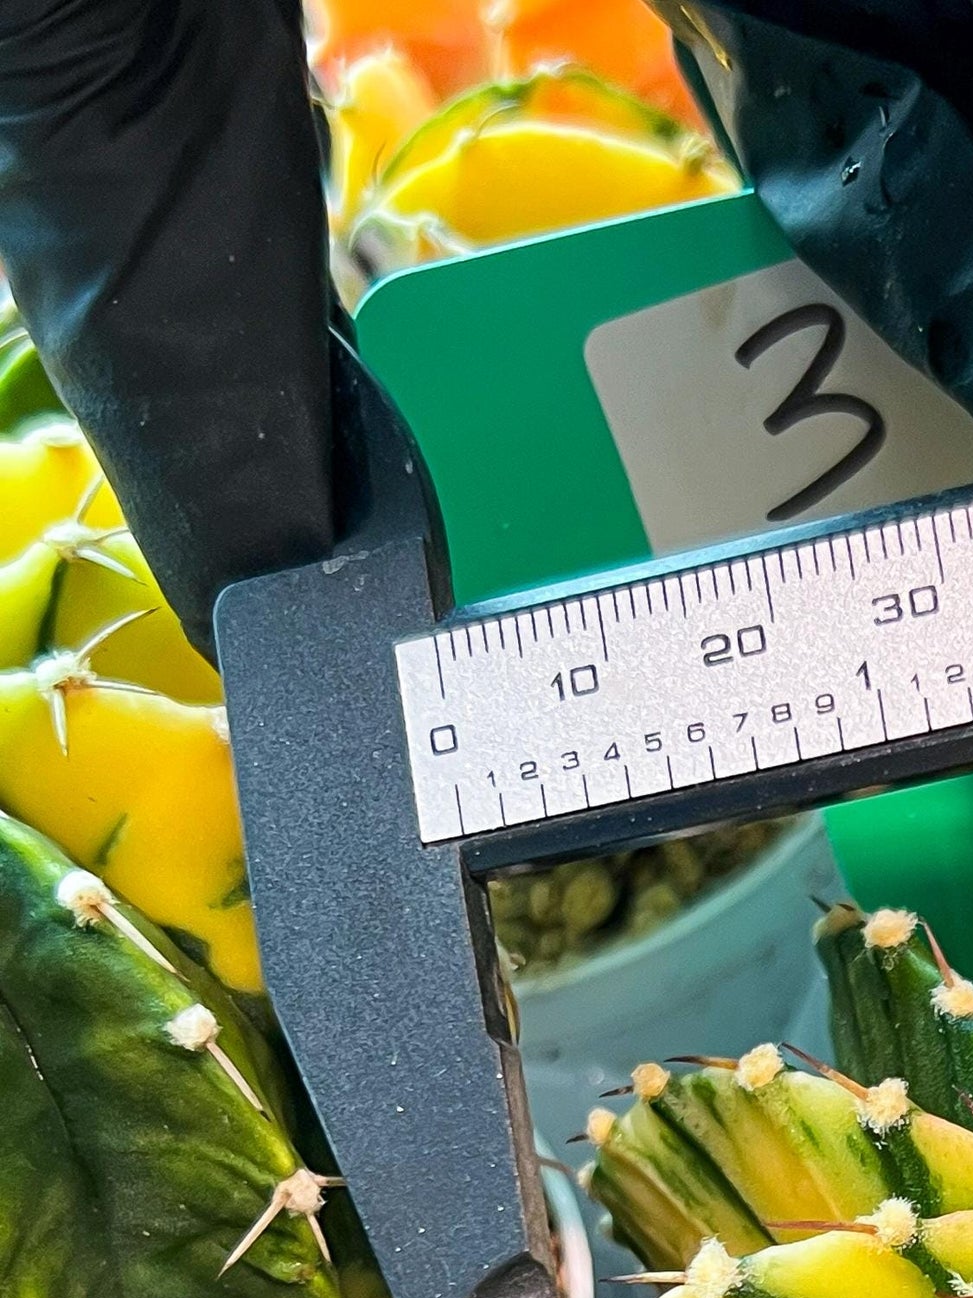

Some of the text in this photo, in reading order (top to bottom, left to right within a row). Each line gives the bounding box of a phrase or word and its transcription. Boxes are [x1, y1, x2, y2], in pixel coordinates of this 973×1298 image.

[732, 302, 887, 521] 3
[550, 664, 599, 701] 10
[700, 624, 767, 667] 20
[871, 584, 939, 626] 30
[429, 724, 458, 756] 0
[487, 770, 496, 788] 1
[519, 760, 539, 781] 2
[560, 750, 580, 771] 3
[603, 742, 621, 761] 4
[644, 731, 663, 753] 5
[686, 722, 706, 743] 6
[732, 712, 749, 733] 7
[770, 702, 792, 723] 8
[815, 693, 835, 715] 9
[855, 660, 871, 690] 1
[910, 673, 920, 692] 1
[944, 663, 966, 685] 2
